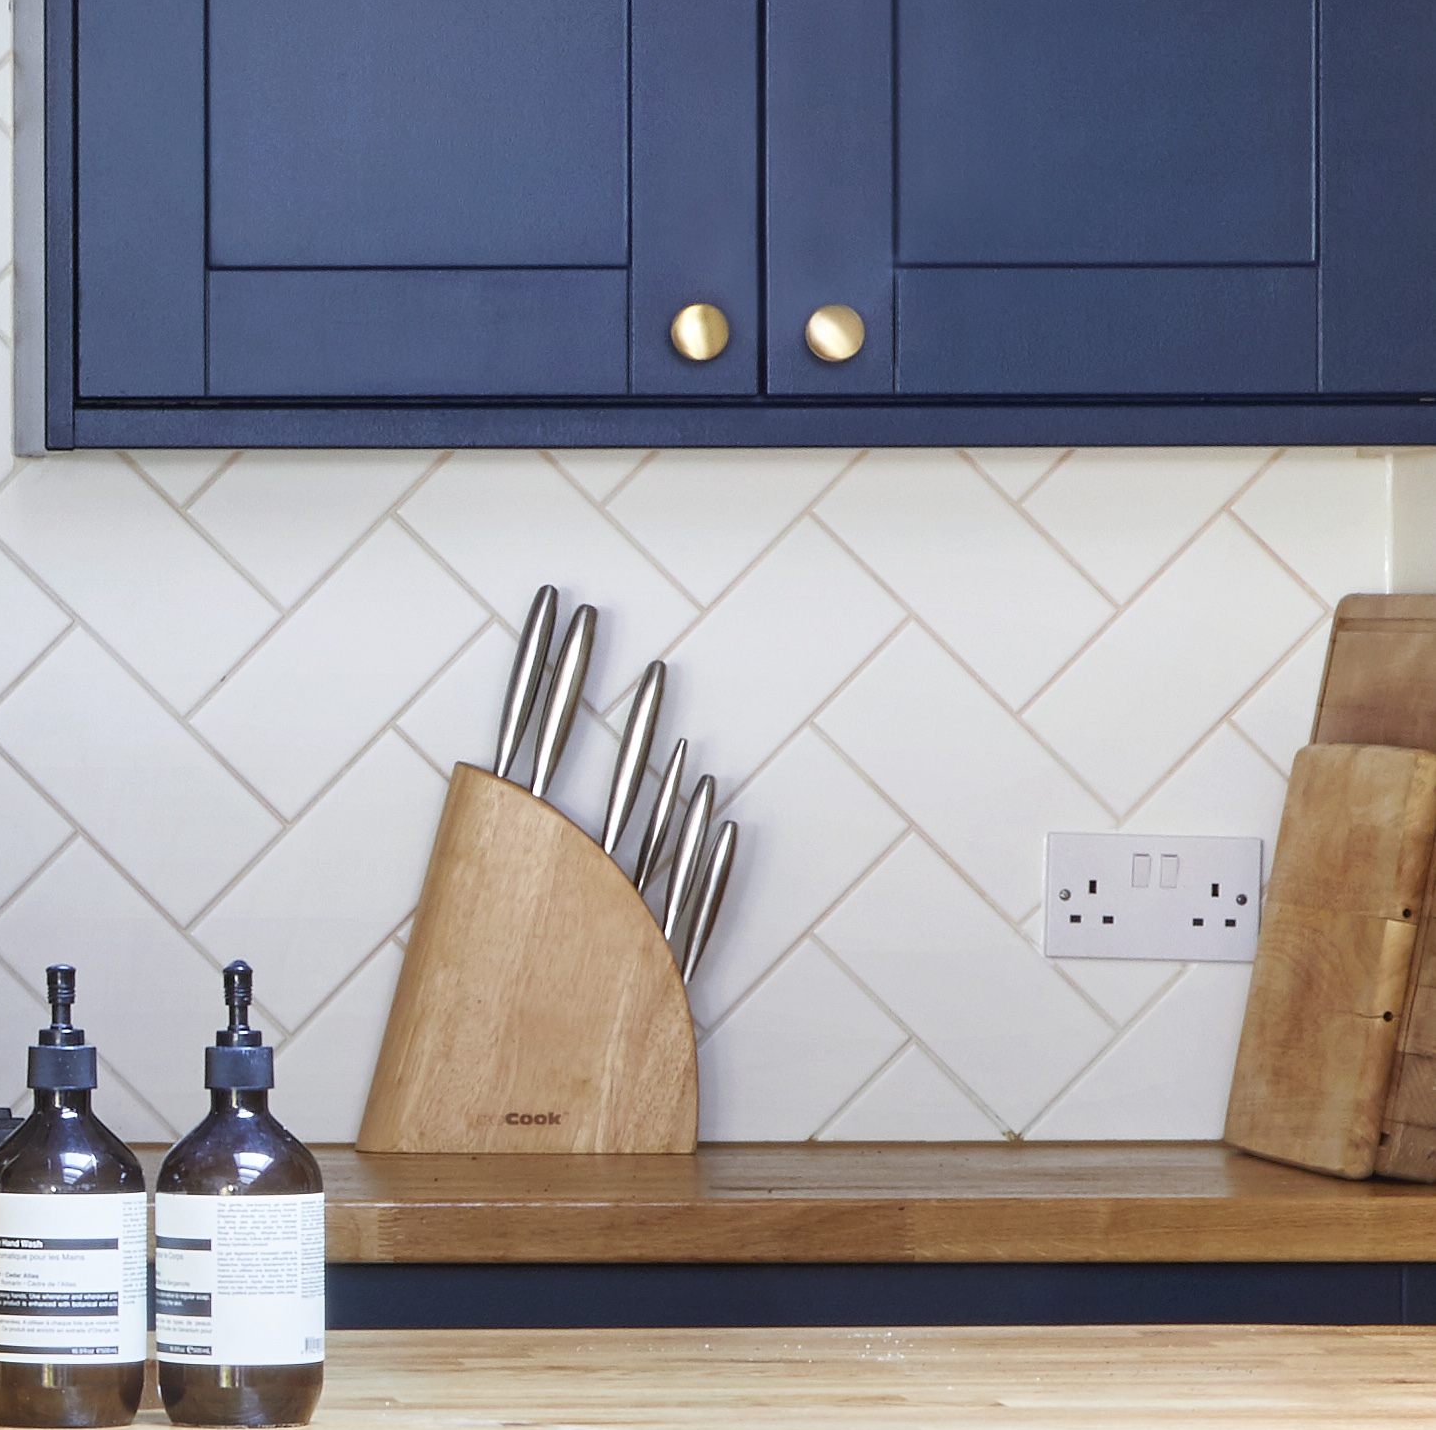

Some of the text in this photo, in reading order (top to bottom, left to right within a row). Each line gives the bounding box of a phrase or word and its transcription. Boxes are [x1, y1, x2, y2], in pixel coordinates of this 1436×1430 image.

[1, 1238, 20, 1248] Hand
[20, 1239, 44, 1249] Wash
[29, 1254, 47, 1262] pour
[48, 1253, 60, 1262] les
[62, 1253, 85, 1262] Mains
